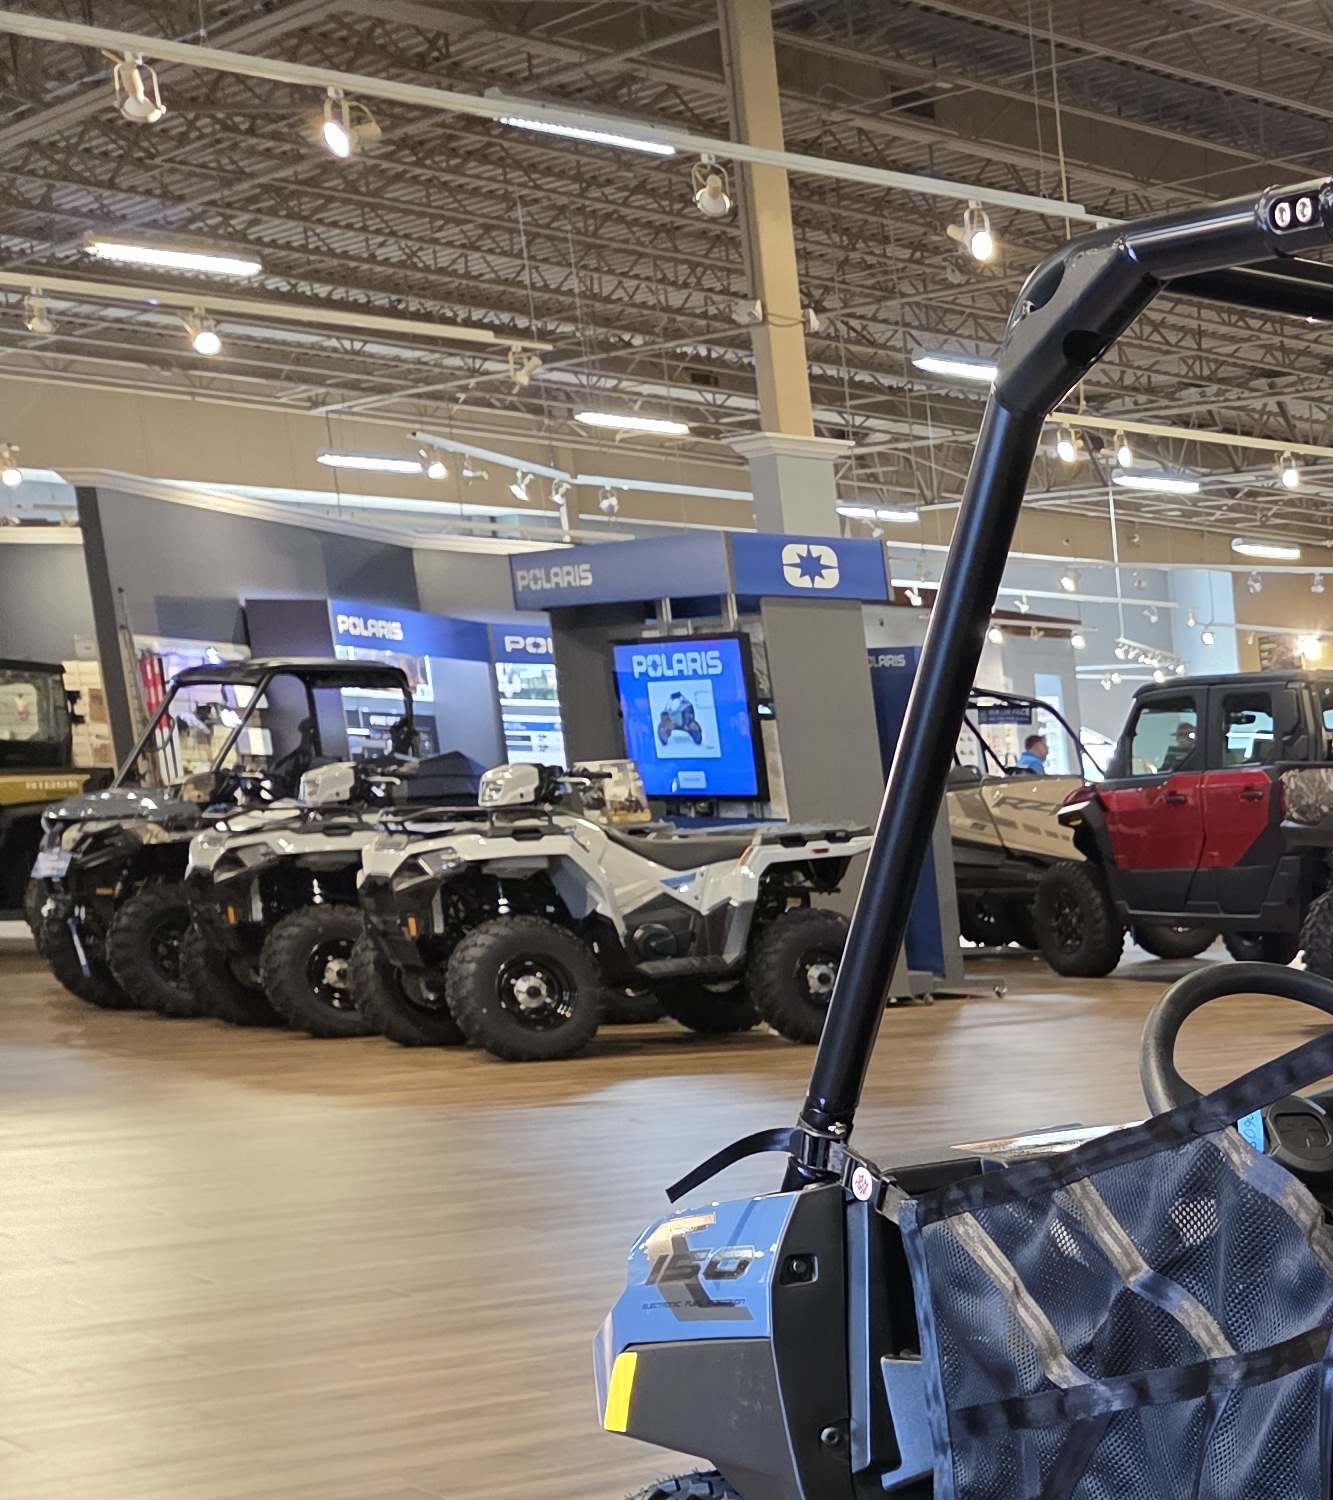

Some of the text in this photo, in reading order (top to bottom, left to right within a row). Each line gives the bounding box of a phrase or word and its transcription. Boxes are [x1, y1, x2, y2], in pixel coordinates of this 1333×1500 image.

[516, 563, 593, 592] POLARIS
[337, 614, 404, 641] POLARIS
[631, 650, 723, 679] POLARIS
[645, 1246, 755, 1286] 150
